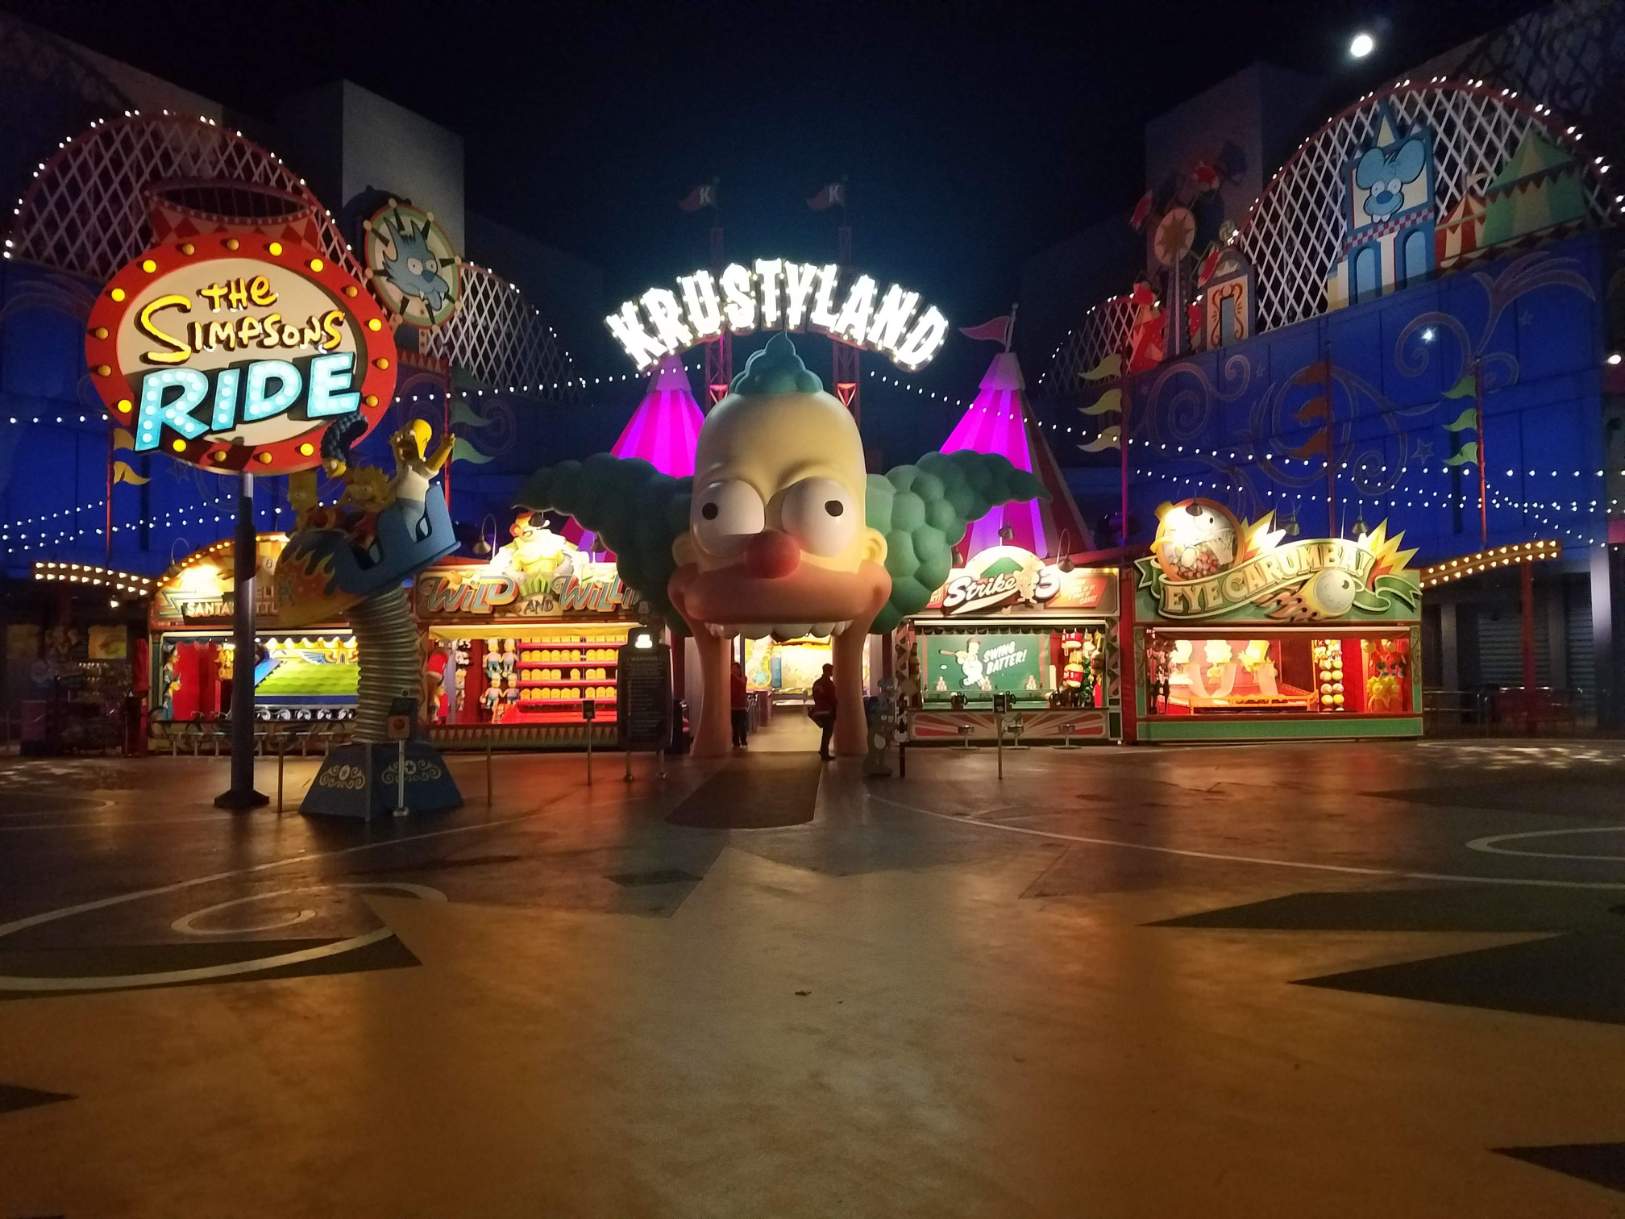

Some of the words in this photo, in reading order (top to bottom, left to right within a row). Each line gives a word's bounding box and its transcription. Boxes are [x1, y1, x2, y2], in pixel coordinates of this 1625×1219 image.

[604, 257, 949, 371] KRUSTYLAND
[134, 351, 361, 452] RIDE
[943, 575, 1018, 608] Strike
[1034, 565, 1061, 600] 3
[524, 596, 555, 615] AND
[983, 640, 1016, 663] SWING
[986, 648, 1028, 675] BATTER!
